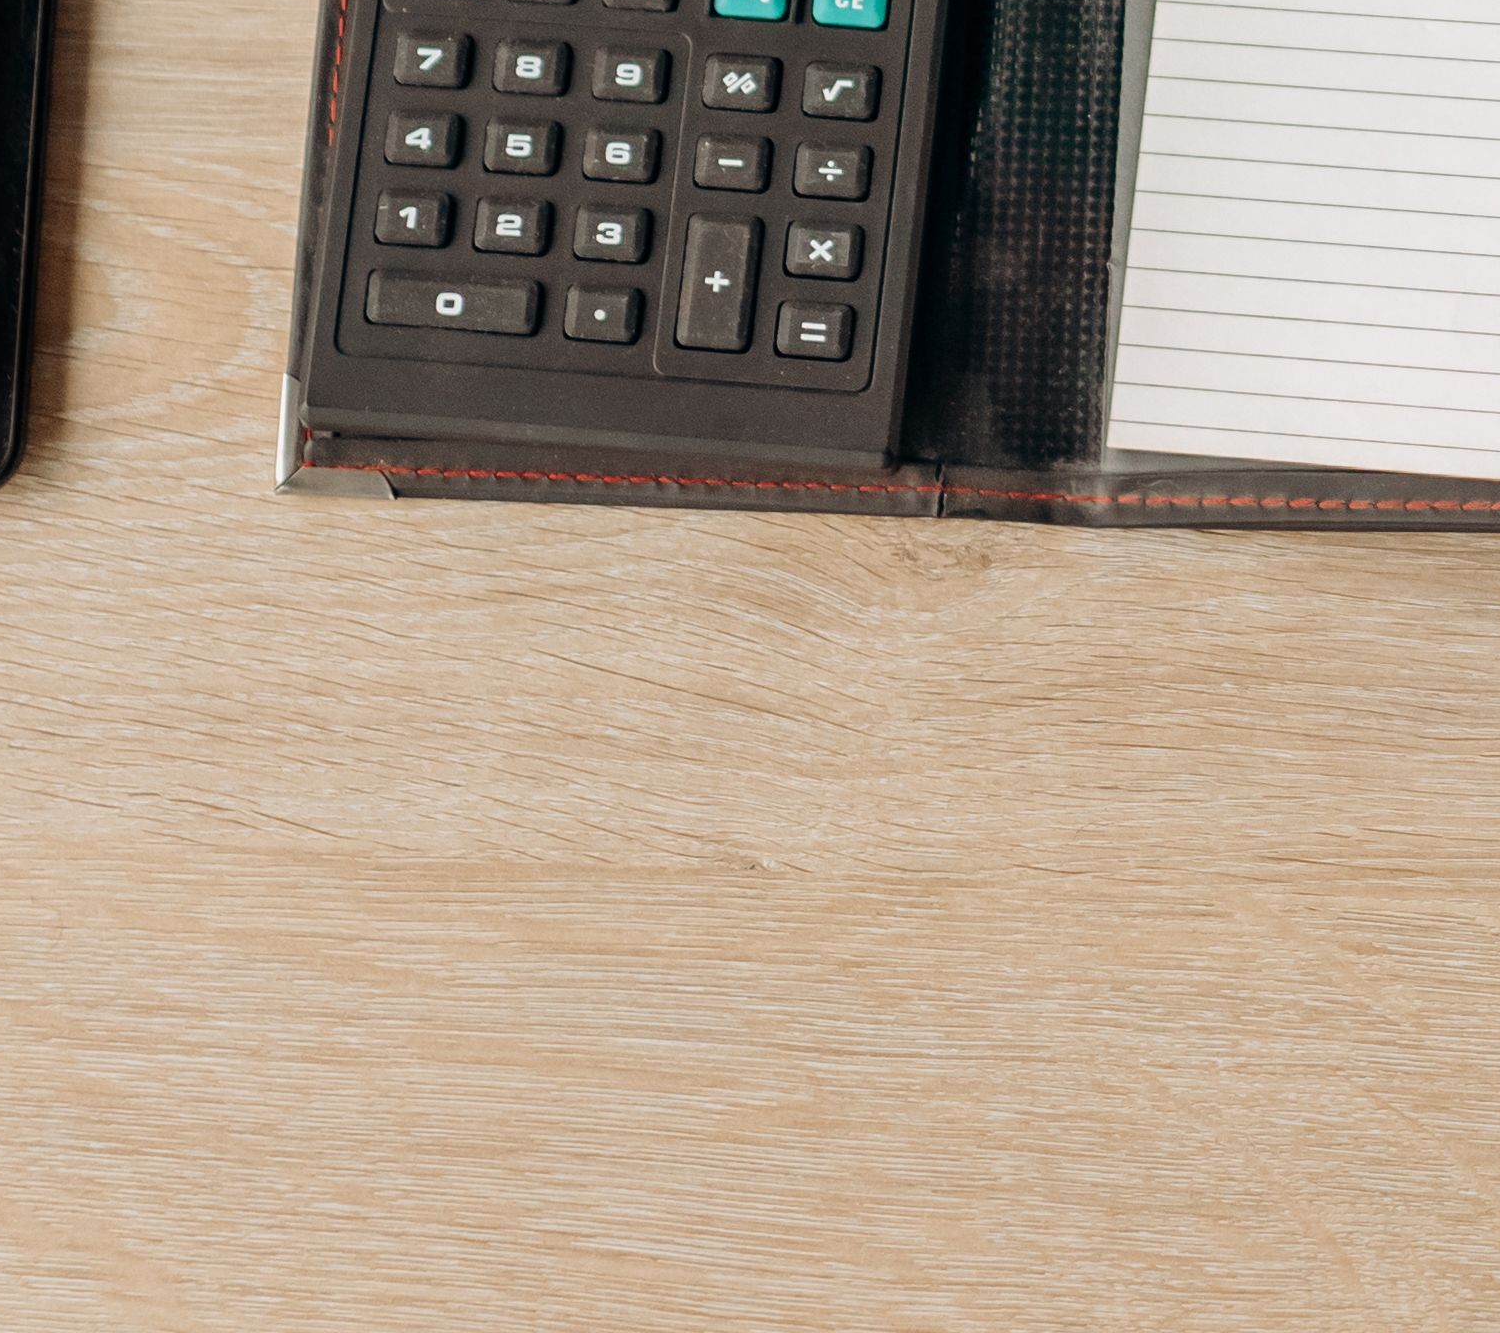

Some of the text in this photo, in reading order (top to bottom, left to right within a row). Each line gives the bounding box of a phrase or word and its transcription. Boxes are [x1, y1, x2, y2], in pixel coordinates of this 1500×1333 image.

[416, 47, 443, 71] 7
[514, 54, 543, 80] 8
[613, 62, 643, 88] 9
[721, 70, 758, 97] %
[403, 125, 433, 151] 4
[504, 132, 533, 159] 5
[604, 139, 632, 166] 6
[398, 205, 419, 230] 1
[495, 212, 523, 238] 2
[595, 220, 623, 246] 3
[434, 291, 465, 317] 0
